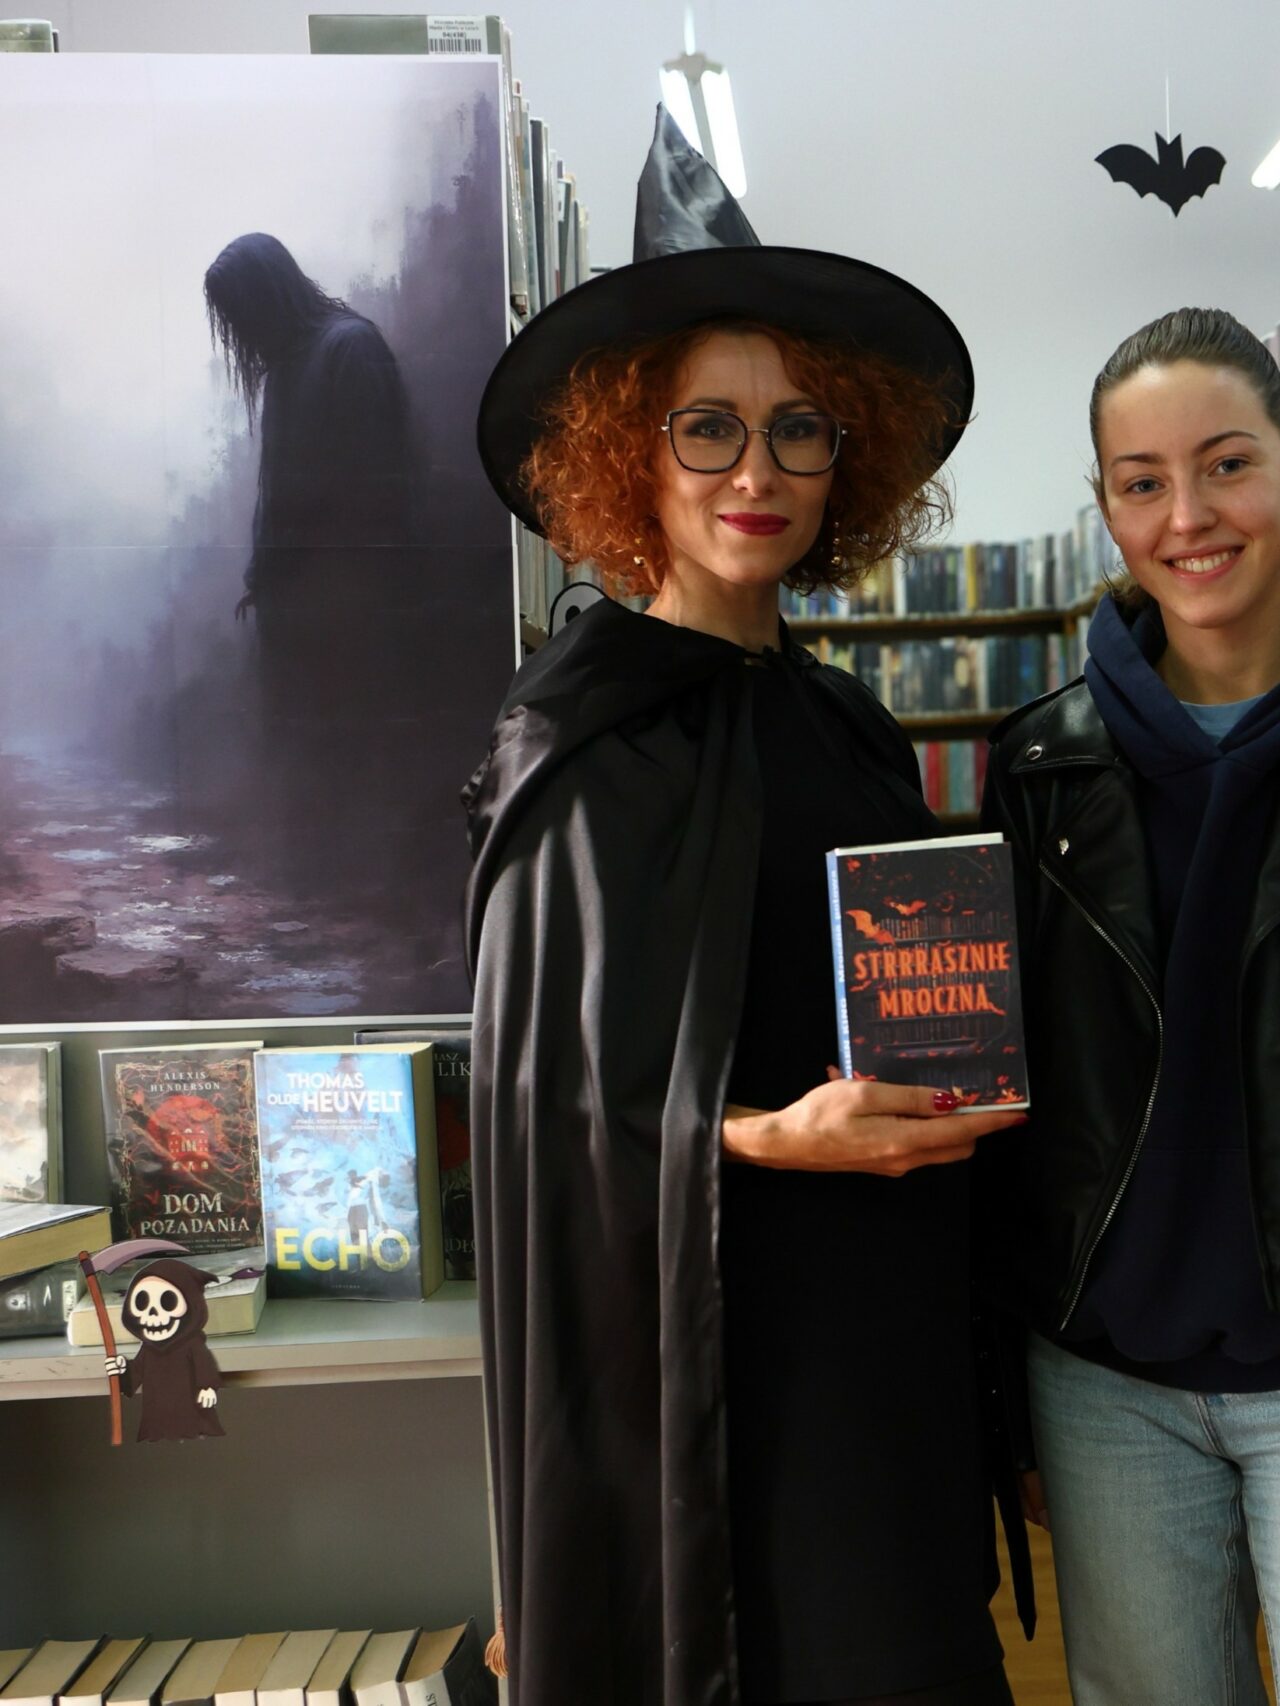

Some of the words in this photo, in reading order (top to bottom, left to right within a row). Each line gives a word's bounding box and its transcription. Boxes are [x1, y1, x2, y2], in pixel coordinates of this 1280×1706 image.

[879, 984, 1004, 1019] MROCZNA
[164, 1072, 207, 1081] ALEXIS
[437, 1061, 472, 1077] LIK
[150, 1082, 220, 1093] HENDERSON
[286, 1072, 364, 1089] THOMAS
[267, 1093, 300, 1105] OLDE
[303, 1090, 403, 1113] HEUVELT
[163, 1192, 224, 1215] DOM
[275, 1228, 411, 1272] ECHO
